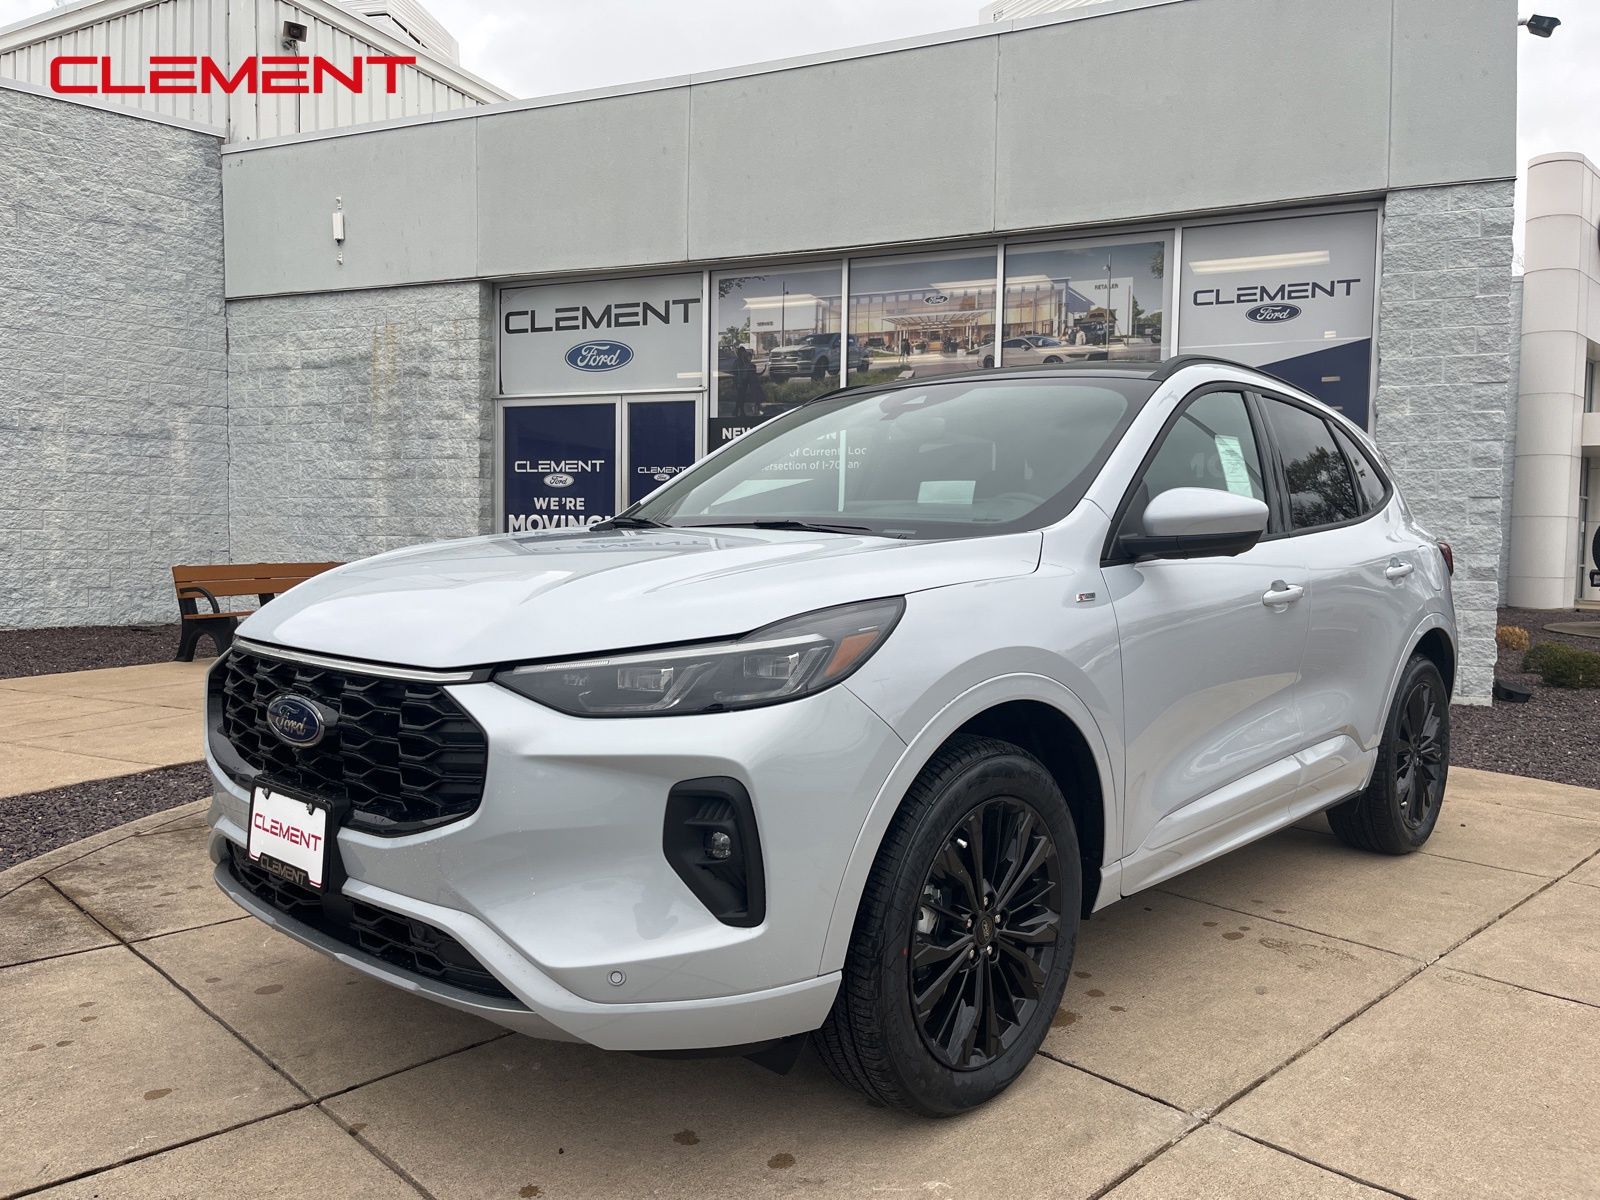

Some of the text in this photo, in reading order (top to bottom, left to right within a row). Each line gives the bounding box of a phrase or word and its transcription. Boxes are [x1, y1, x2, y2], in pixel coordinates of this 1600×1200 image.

[1193, 278, 1361, 306] CLEMENT
[504, 298, 701, 335] CLEMENT
[1256, 306, 1290, 320] Ford
[577, 344, 622, 368] Ford
[514, 460, 605, 473] CLEMENT
[637, 466, 687, 474] CLEMENT
[762, 461, 807, 471] ersection
[810, 461, 820, 470] of
[549, 475, 569, 485] Ford
[533, 497, 585, 511] WE'RE
[275, 704, 307, 736] Ford
[253, 812, 322, 852] CLEMENT
[260, 856, 307, 886] CLEMENT
